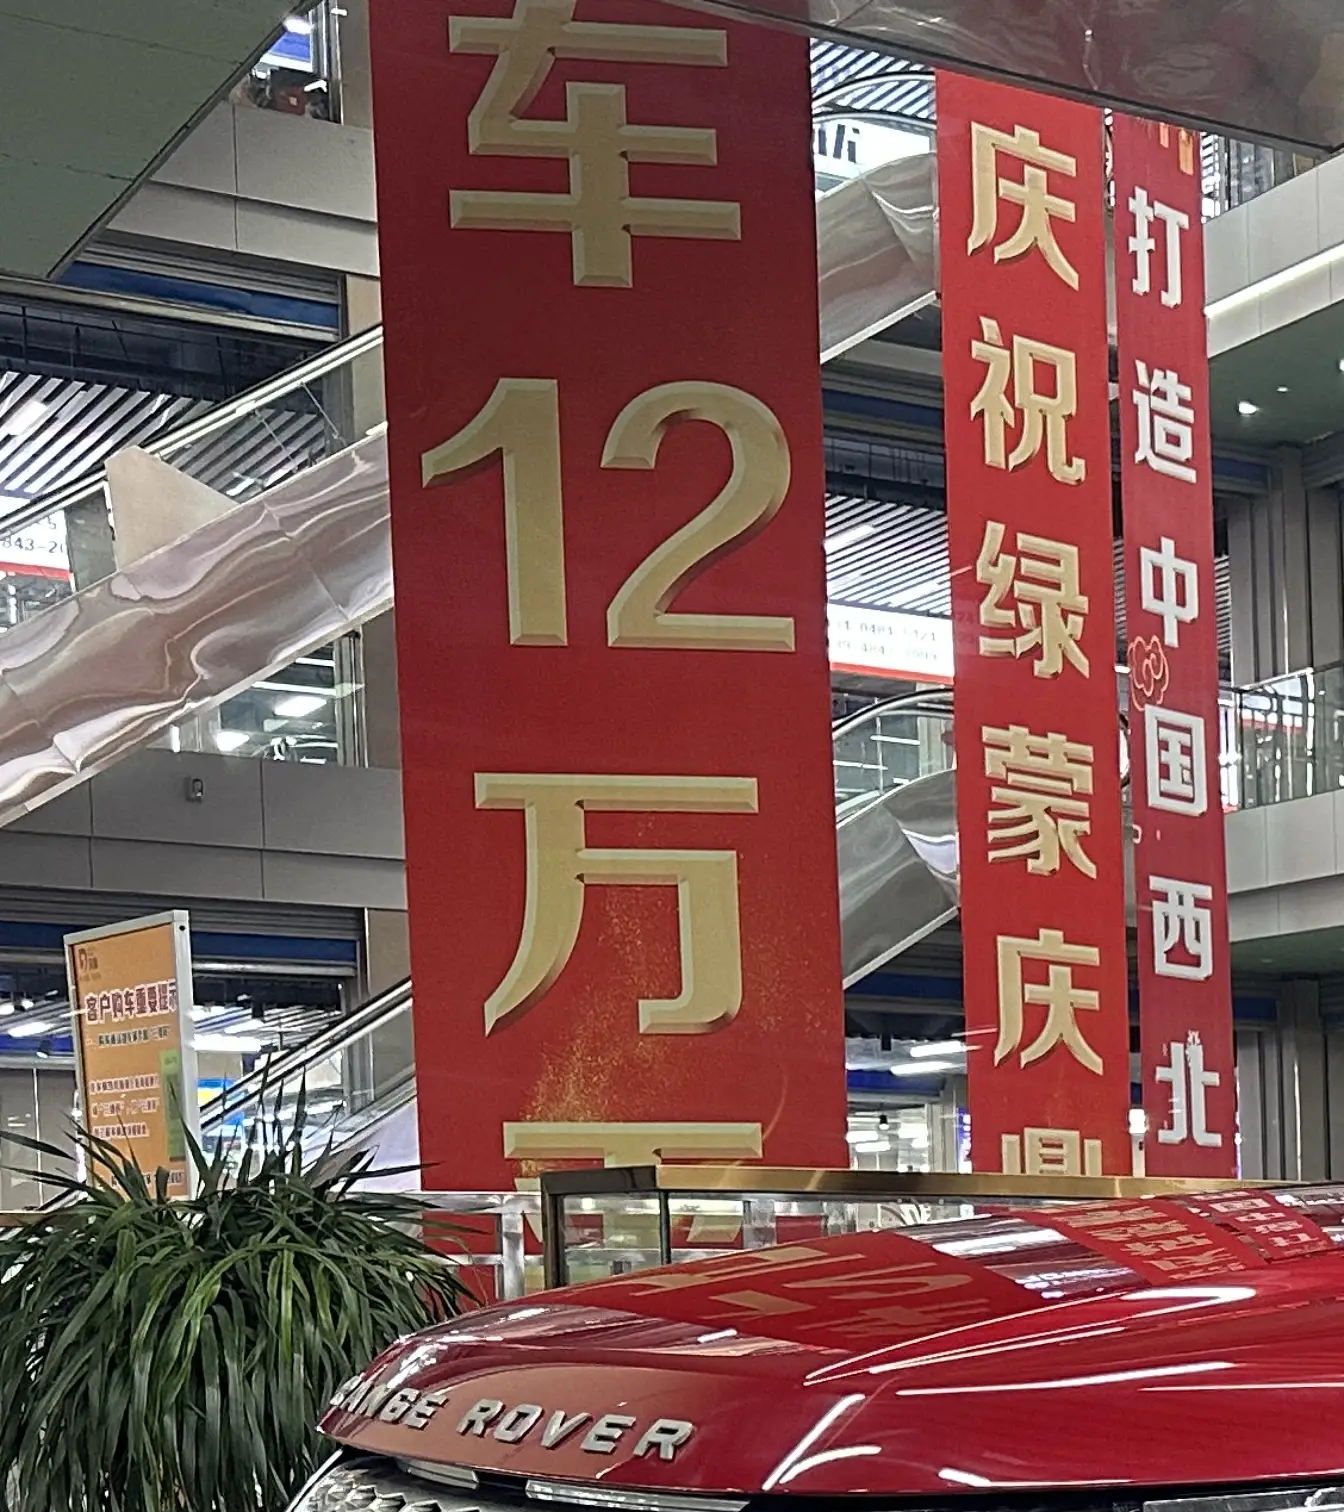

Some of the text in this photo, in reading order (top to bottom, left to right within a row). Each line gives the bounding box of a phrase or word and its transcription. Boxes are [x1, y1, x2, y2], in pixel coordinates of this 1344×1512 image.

[1127, 184, 1222, 1148] 打造中国西北
[85, 979, 177, 1025] 客户购车重要提示
[456, 1398, 695, 1461] ROVER
